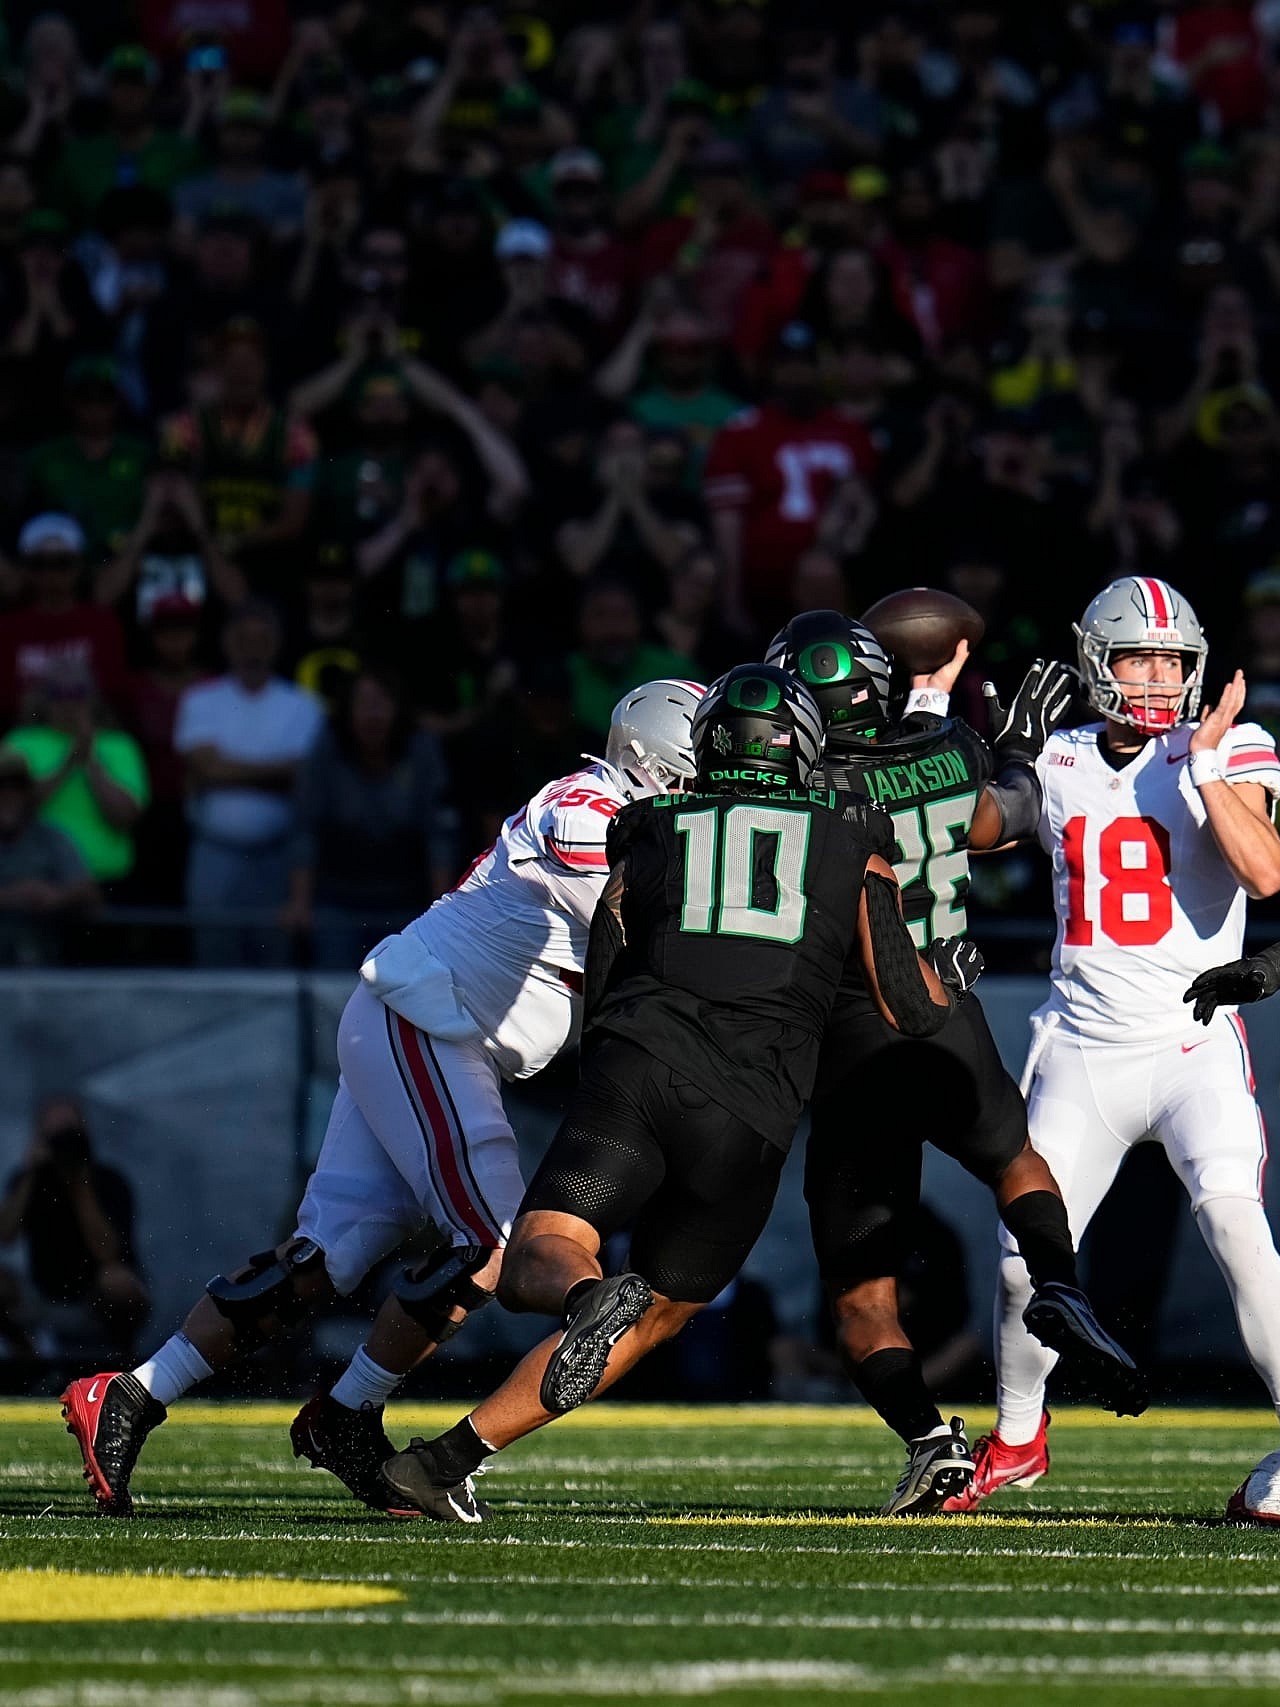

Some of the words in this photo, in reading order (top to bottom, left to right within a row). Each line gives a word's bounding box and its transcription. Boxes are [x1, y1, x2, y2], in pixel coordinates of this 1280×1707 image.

[709, 769, 789, 786] DUCKS
[863, 750, 969, 803] JACKSON
[559, 789, 623, 818] 56
[674, 803, 811, 945] 10
[1063, 816, 1173, 946] 18
